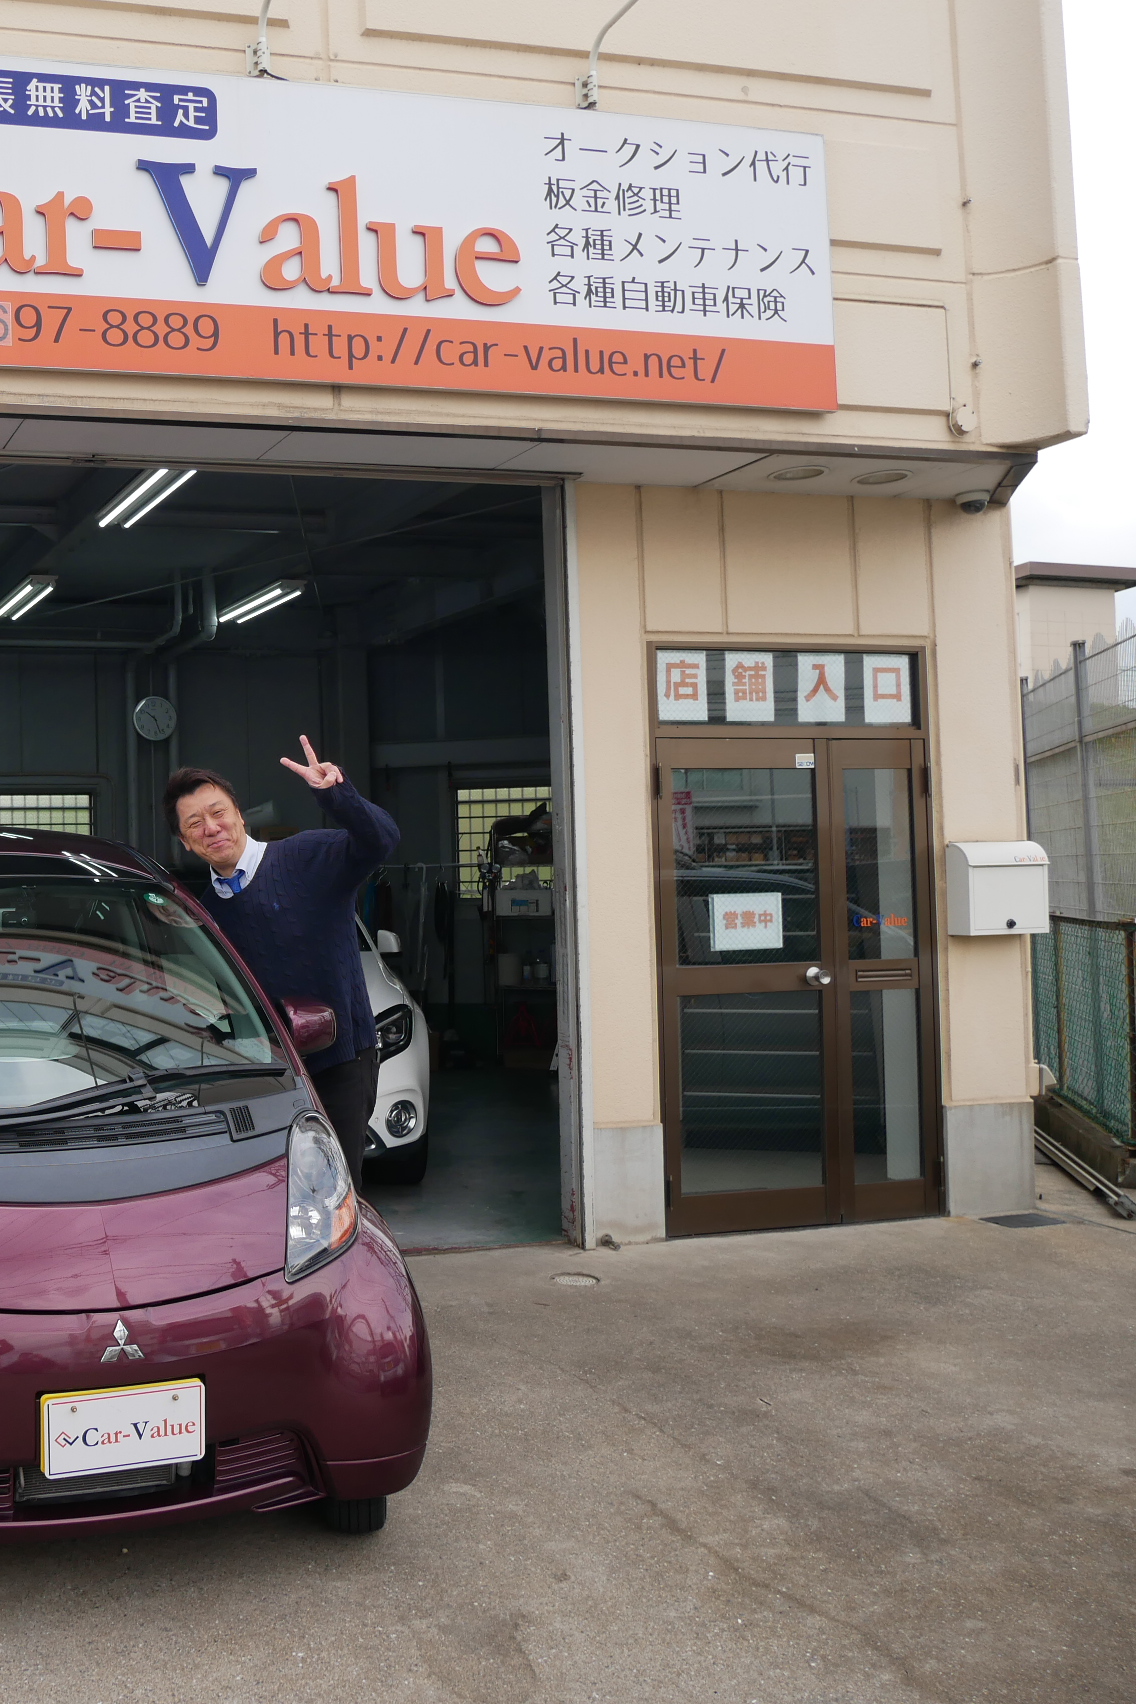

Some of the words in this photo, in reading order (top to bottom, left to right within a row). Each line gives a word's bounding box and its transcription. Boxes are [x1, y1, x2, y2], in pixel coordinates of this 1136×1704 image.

[543, 131, 812, 188] オークション代行
[543, 176, 682, 221] 板金修理
[545, 223, 817, 277] 各種メンテナンス
[547, 271, 788, 323] 各種自動車保険
[272, 317, 727, 385] http://car-value.net/
[663, 659, 903, 703] 店舗入口
[81, 1417, 197, 1447] Car-Value
